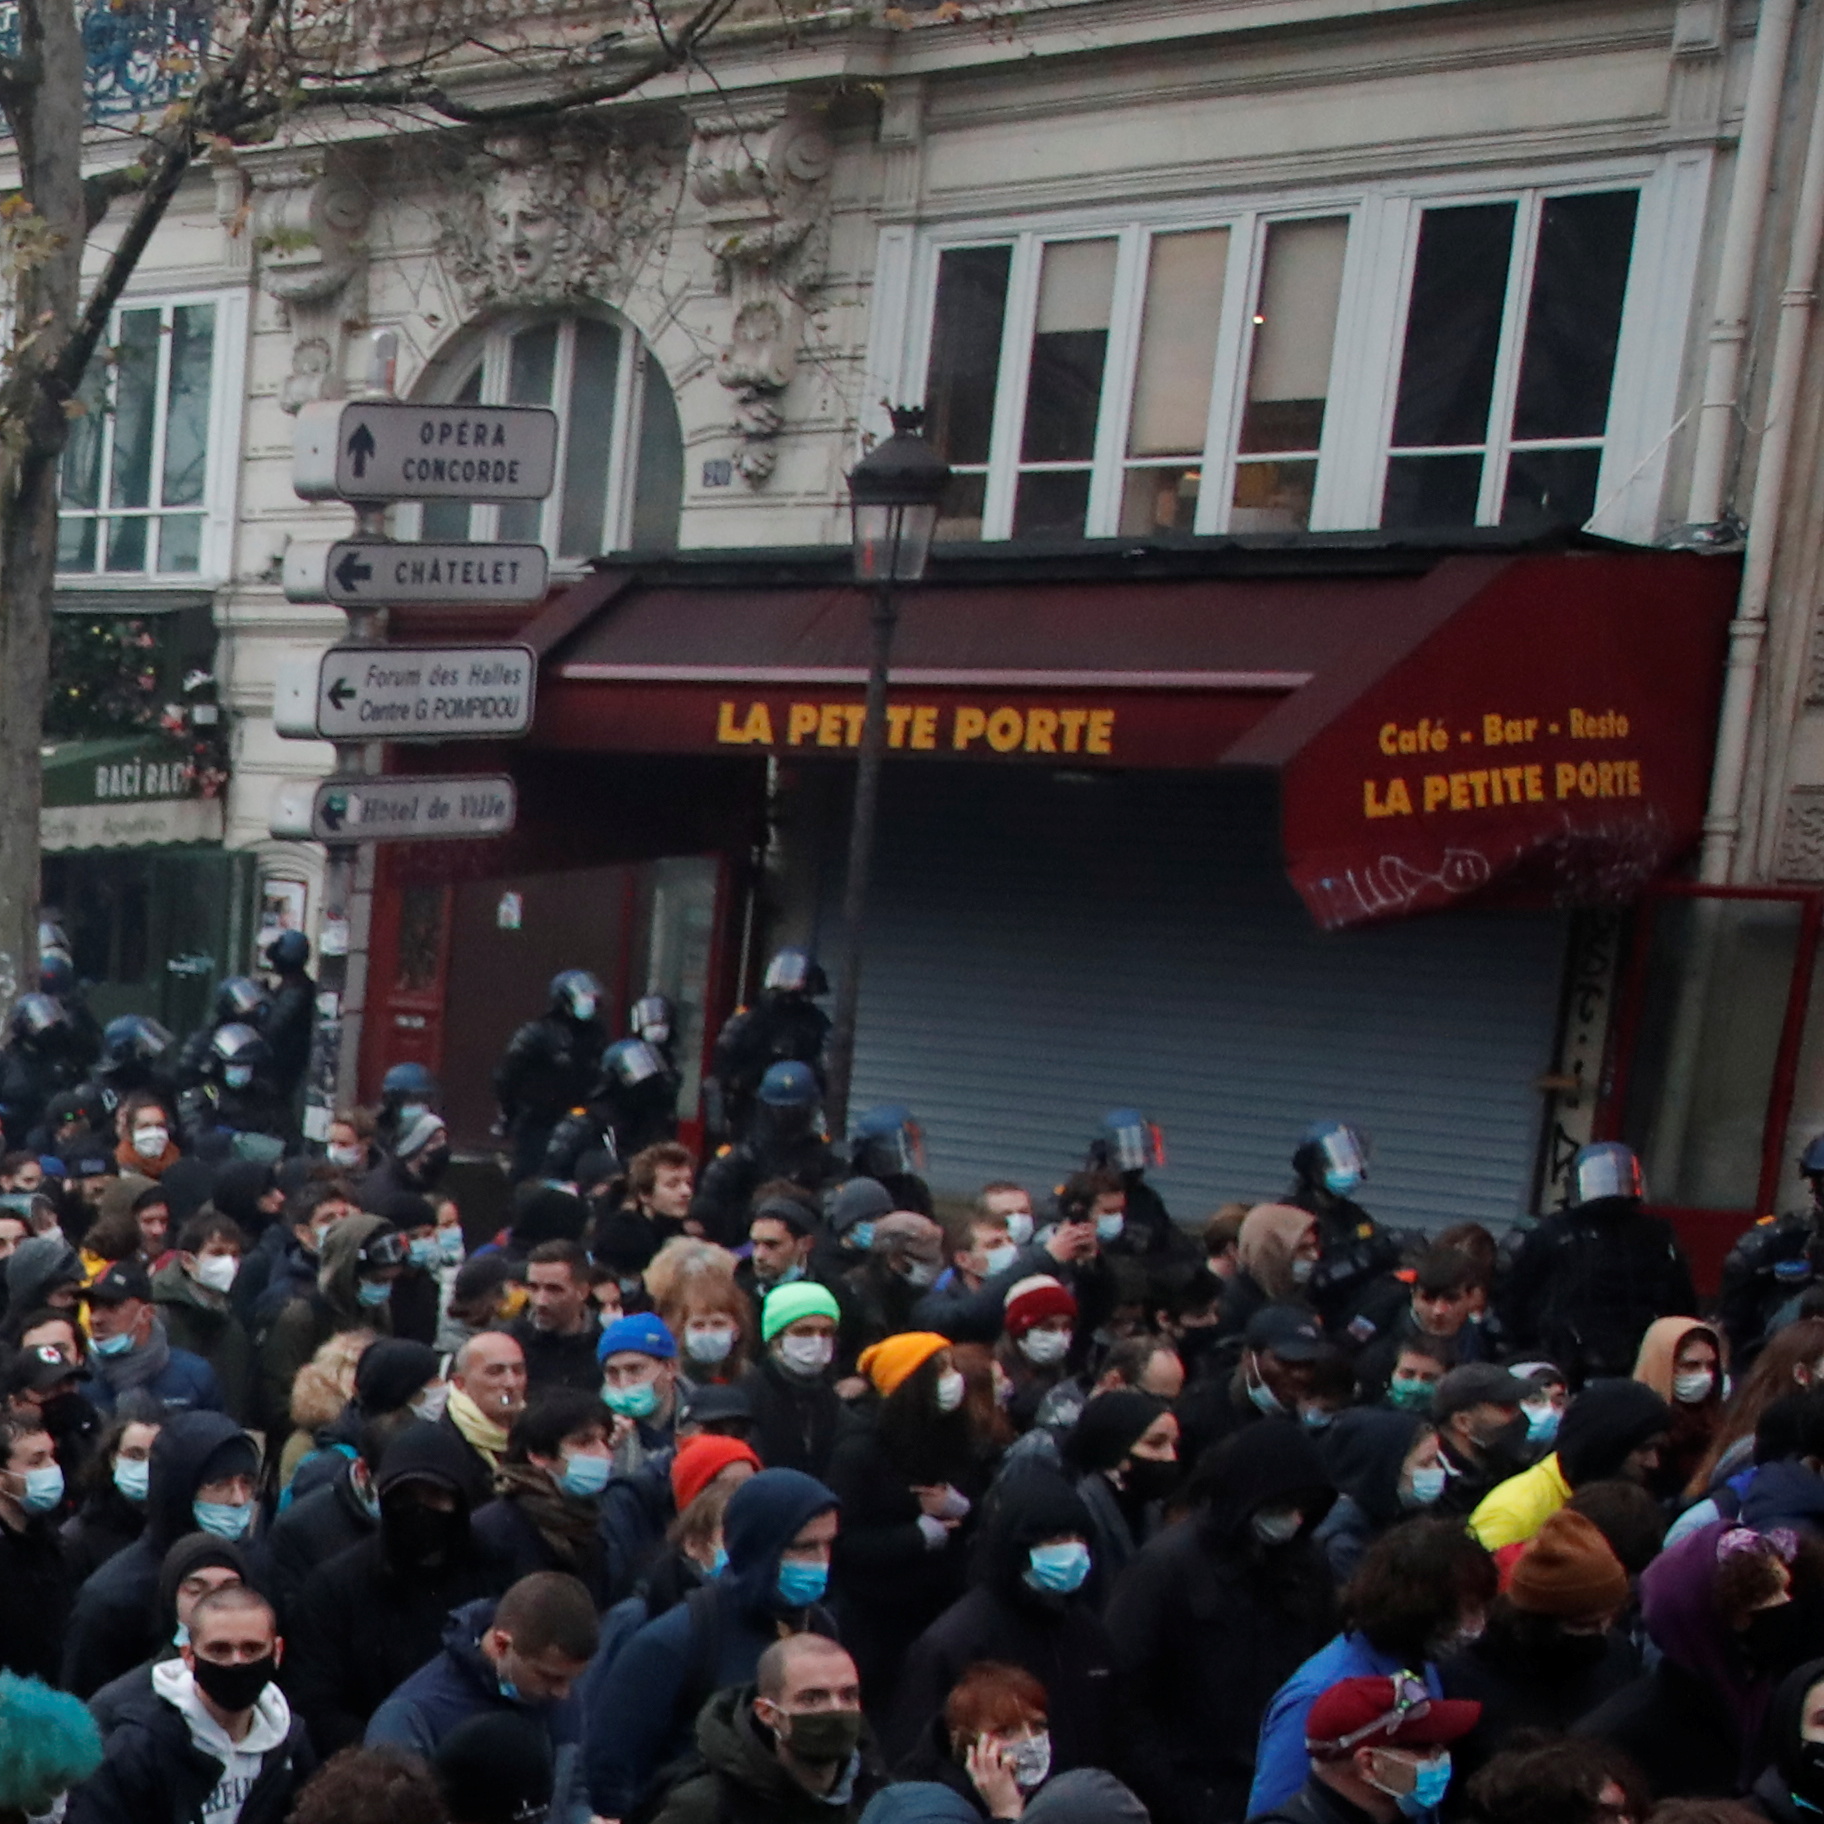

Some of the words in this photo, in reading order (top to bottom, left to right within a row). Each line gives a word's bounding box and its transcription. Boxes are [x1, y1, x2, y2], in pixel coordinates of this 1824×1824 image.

[419, 419, 507, 447] OPÉRA
[402, 457, 520, 484] CONCORDE
[394, 558, 521, 585] CHÂTELET
[366, 664, 421, 688] Forum
[428, 663, 459, 686] des
[468, 663, 522, 687] Halles
[359, 698, 411, 722] Centre
[433, 695, 520, 720] POMPIDOU
[717, 701, 774, 746] LA
[788, 703, 939, 750] PETTE
[955, 706, 1115, 755] PORTE
[1378, 717, 1449, 756] Café
[1483, 711, 1539, 746] Bar
[1569, 707, 1630, 739] Resto
[1363, 777, 1414, 819] LA
[1423, 765, 1545, 813] PETITE
[1555, 759, 1642, 800] PORTE
[427, 797, 450, 819] de
